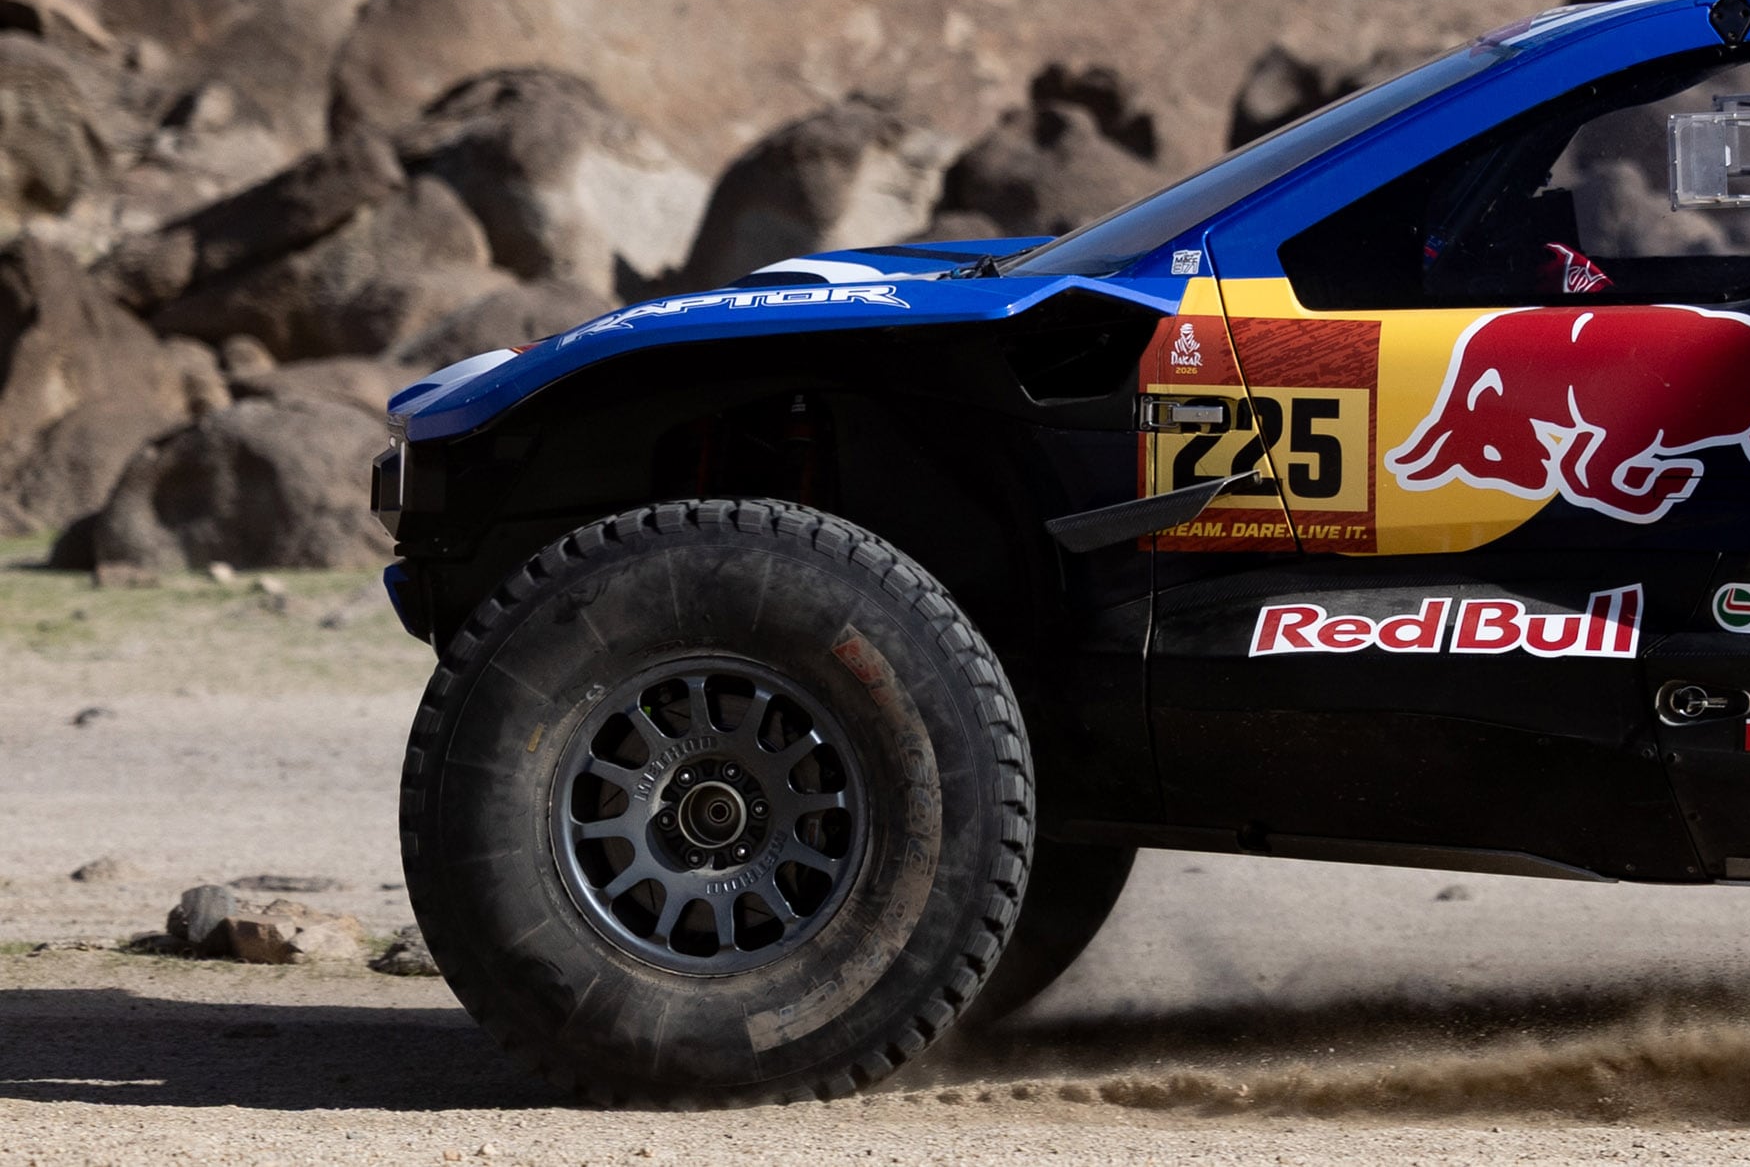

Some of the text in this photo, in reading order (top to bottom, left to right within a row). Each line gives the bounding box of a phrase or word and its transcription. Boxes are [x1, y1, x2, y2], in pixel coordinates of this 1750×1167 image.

[556, 285, 911, 350] RAPTOR
[1170, 350, 1203, 367] DAKAR
[1174, 366, 1199, 375] 2026
[1172, 396, 1343, 499] 225
[1344, 526, 1368, 540] IT.
[1253, 588, 1641, 654] Red Bull
